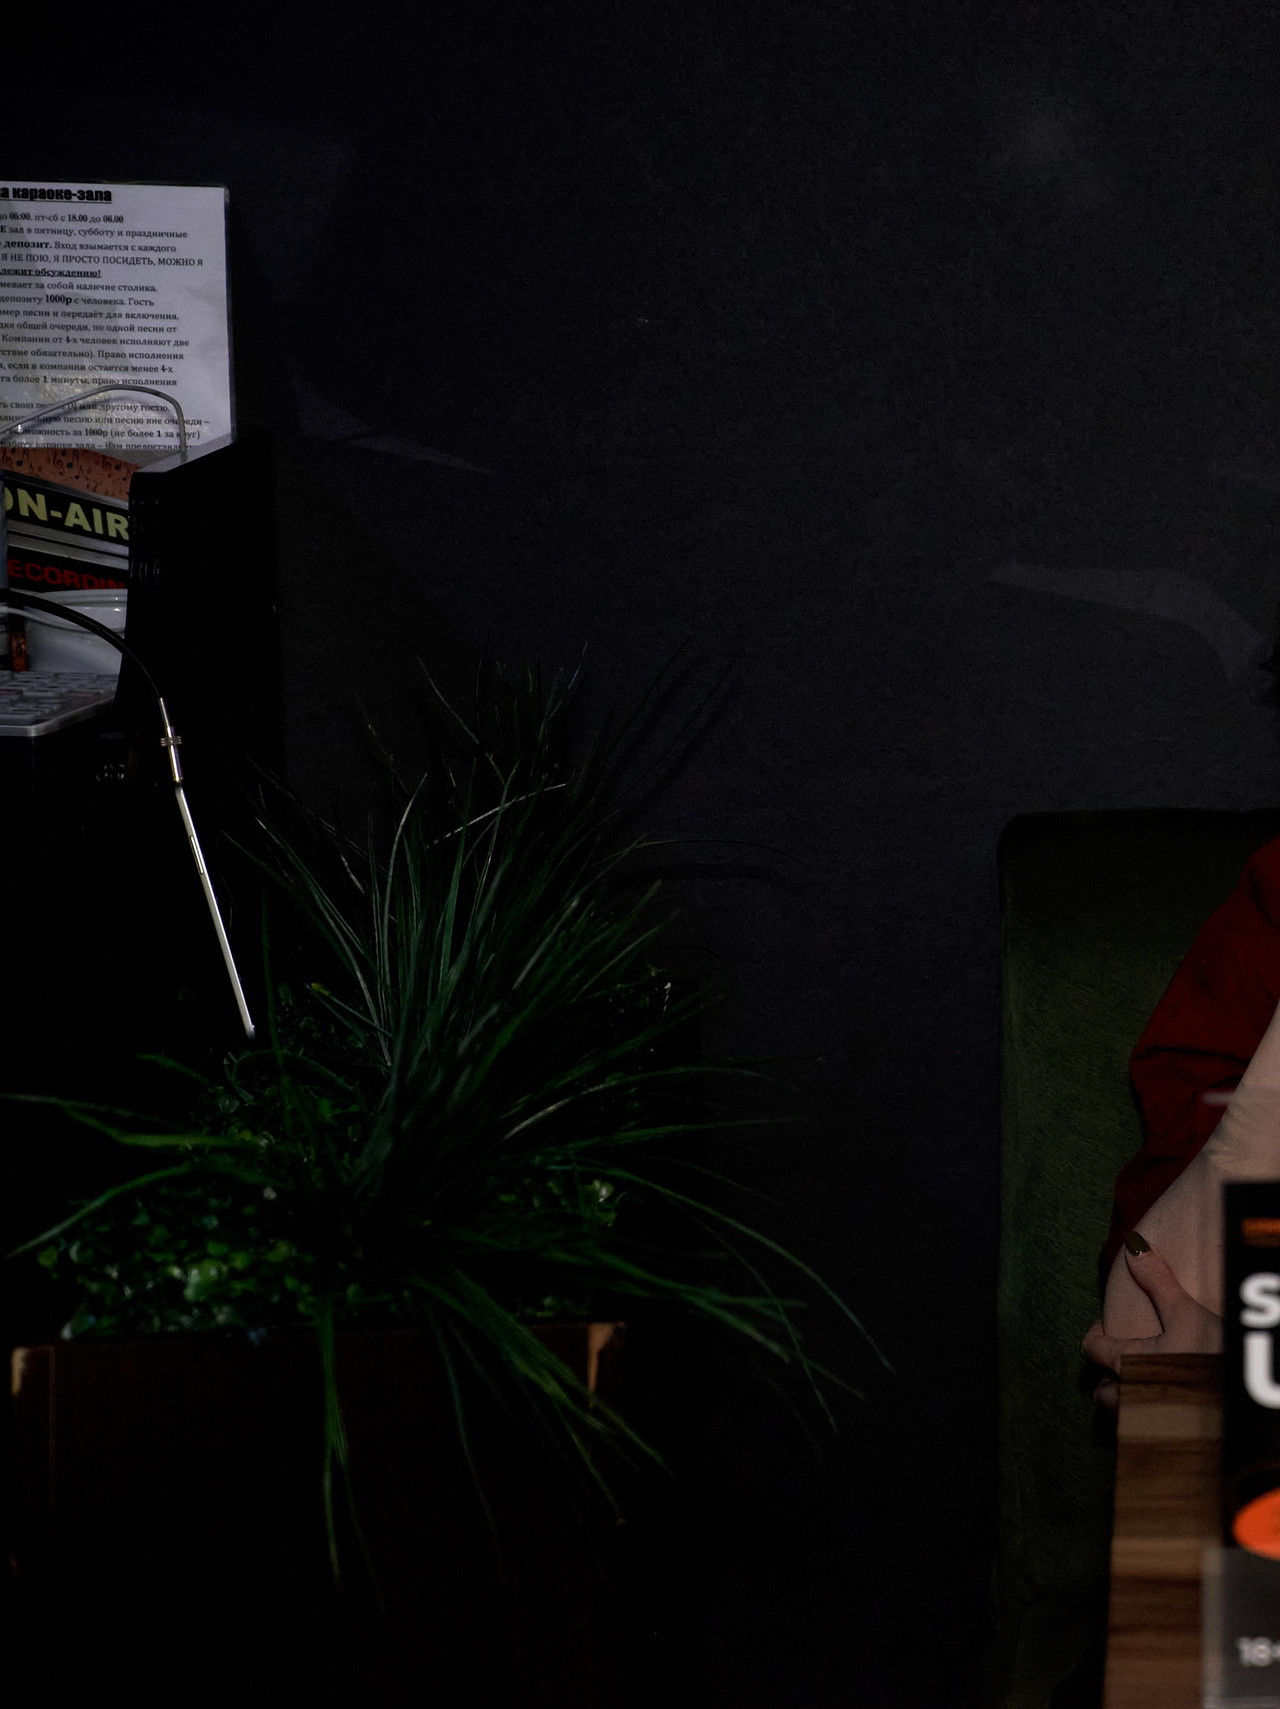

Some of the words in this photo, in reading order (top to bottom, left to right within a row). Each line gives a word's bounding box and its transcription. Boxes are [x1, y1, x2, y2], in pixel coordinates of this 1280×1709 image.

[12, 187, 112, 203] караоке-зала
[34, 213, 58, 222] пт-сб
[68, 213, 88, 222] 18.00
[103, 215, 124, 224] 06.00
[78, 227, 115, 238] субботу
[125, 230, 188, 239] праздничные
[3, 240, 52, 249] депозит.
[54, 241, 77, 251] Вход
[79, 243, 129, 251] взымается
[138, 244, 176, 253] каждого
[1, 253, 8, 261] Я
[10, 253, 24, 262] НЕ
[53, 255, 59, 263] Я
[62, 255, 100, 264] ПРОСТО
[102, 256, 156, 266] ПОСИДЕТЬ,
[157, 258, 195, 267] МОЖНО
[35, 268, 101, 278] обсуждению!
[47, 281, 74, 290] собой
[76, 283, 116, 291] наличие
[118, 284, 157, 292] столика.
[45, 294, 72, 305] 1000р
[128, 297, 154, 306] Гость
[22, 309, 50, 317] песни
[61, 310, 103, 319] передаёт
[125, 312, 179, 320] включения.
[17, 321, 48, 330] общей
[50, 323, 90, 332] очереди,
[106, 324, 135, 333] одной
[137, 325, 164, 333] песни
[2, 334, 50, 343] Компании
[65, 335, 78, 344] 4-х
[80, 337, 118, 345] человек
[173, 339, 189, 347] две
[97, 350, 126, 360] Право
[129, 352, 184, 360] исполнения
[39, 363, 86, 371] компании
[88, 364, 129, 372] остается
[131, 365, 159, 373] менее
[160, 364, 174, 373] 4-х
[12, 374, 40, 383] более
[43, 375, 48, 383] 1
[92, 378, 119, 386] право
[99, 403, 138, 413] другому
[140, 404, 170, 412] гостю.
[115, 417, 143, 425] песню
[85, 428, 108, 437] 1000р
[127, 429, 154, 438] более
